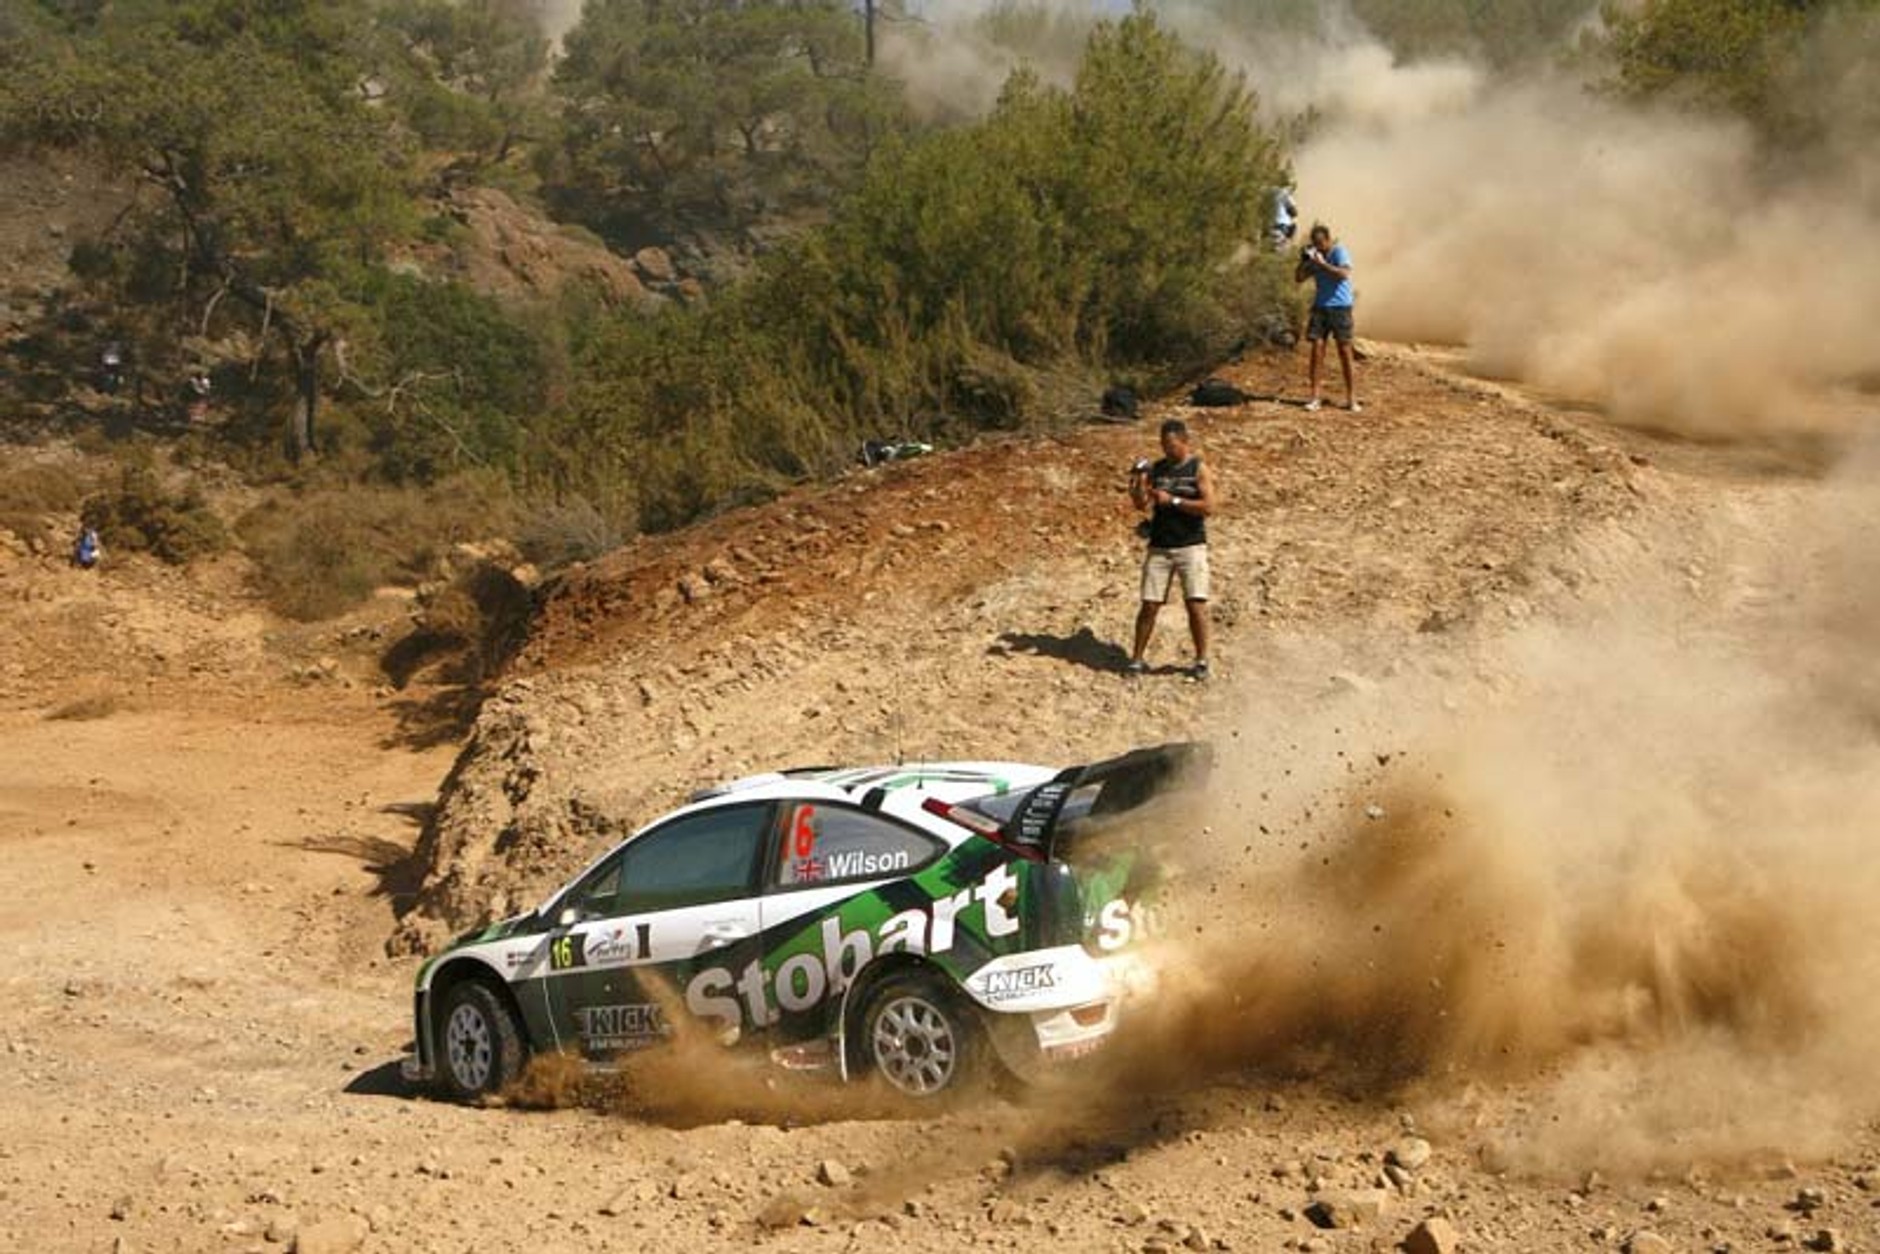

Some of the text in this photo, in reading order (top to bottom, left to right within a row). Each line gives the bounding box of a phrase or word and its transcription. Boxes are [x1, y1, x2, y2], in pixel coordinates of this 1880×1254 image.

[827, 849, 909, 878] Wilson
[552, 936, 574, 968] 16
[686, 863, 1020, 1047] Stobart
[986, 963, 1055, 995] KICK
[584, 1004, 663, 1037] KICK
